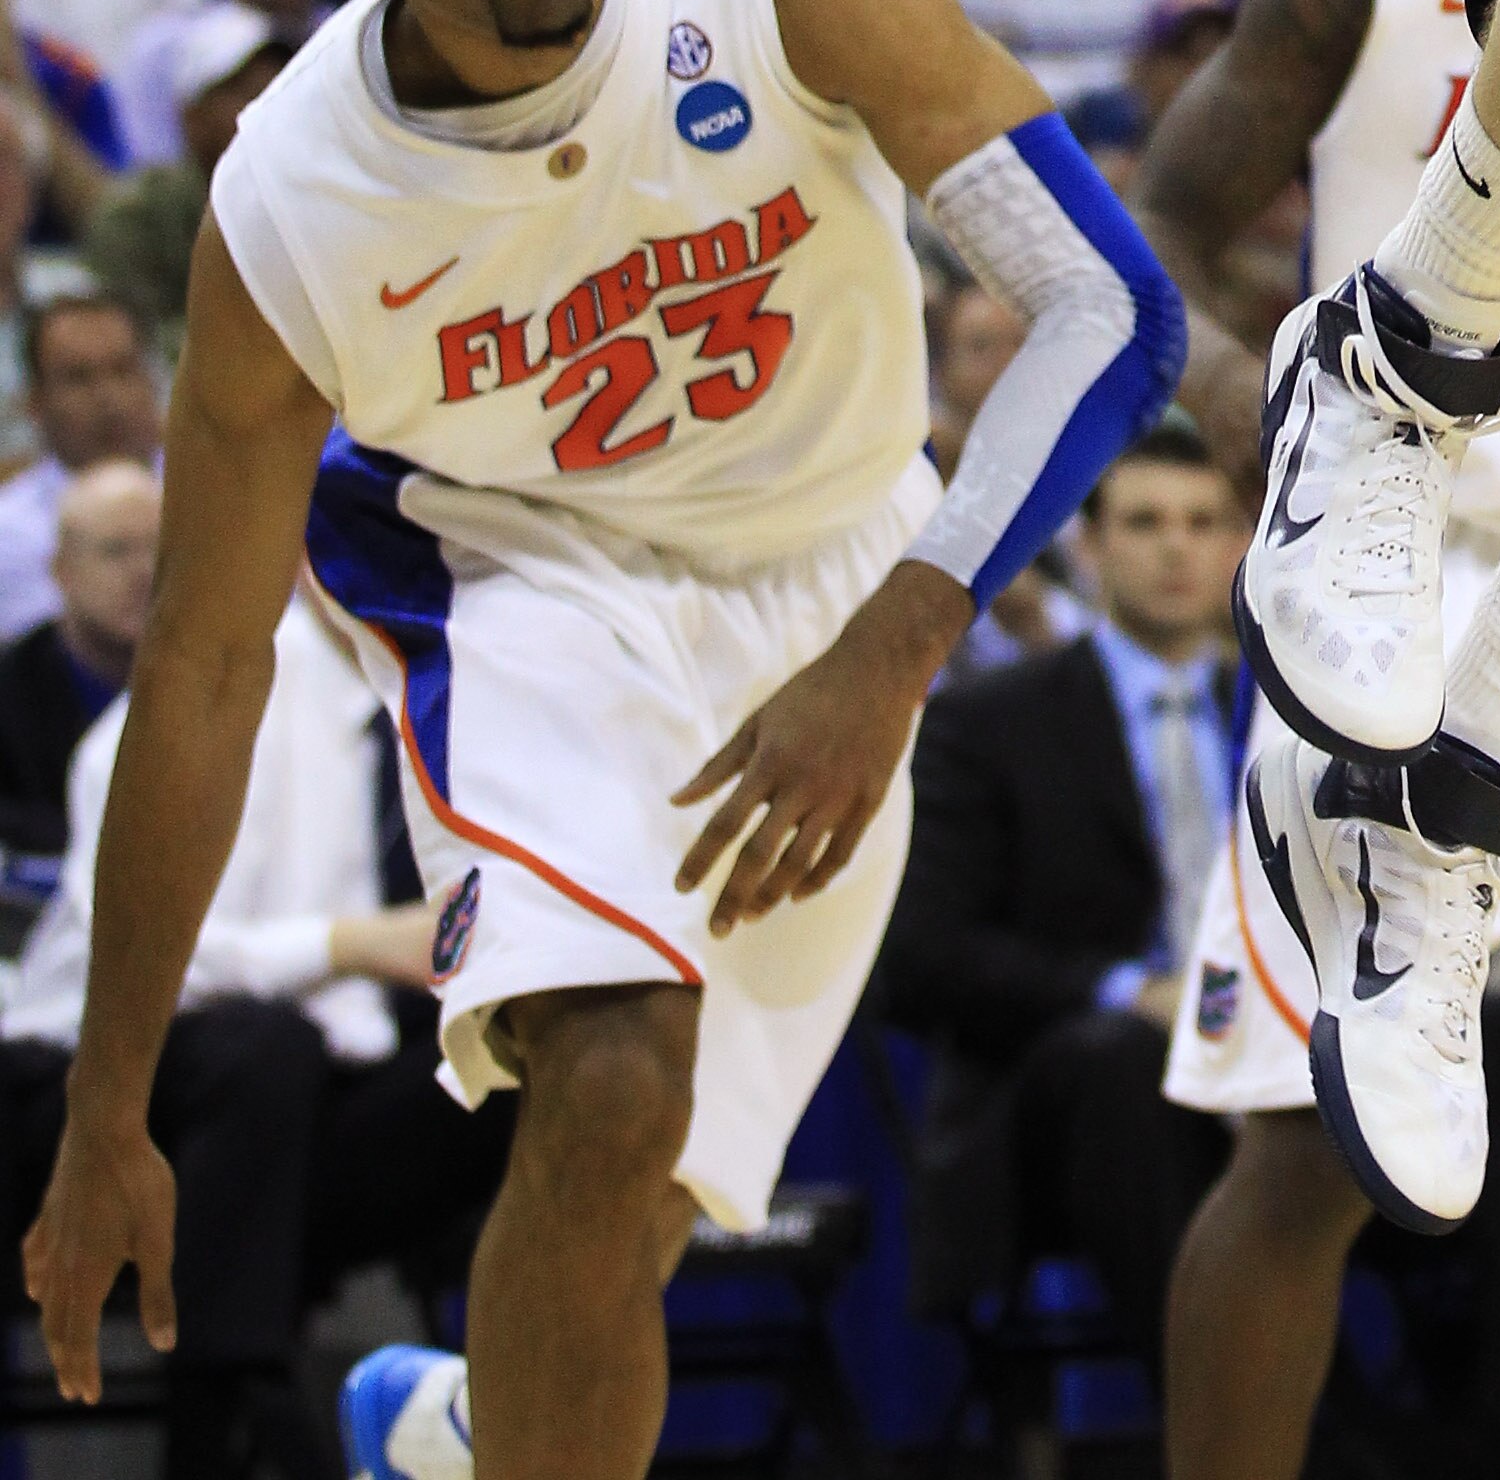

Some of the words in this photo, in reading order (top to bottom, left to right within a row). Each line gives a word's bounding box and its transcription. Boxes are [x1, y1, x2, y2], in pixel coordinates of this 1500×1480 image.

[689, 104, 746, 141] NCAA
[437, 185, 819, 404] FLORIDA
[541, 269, 794, 473] 23
